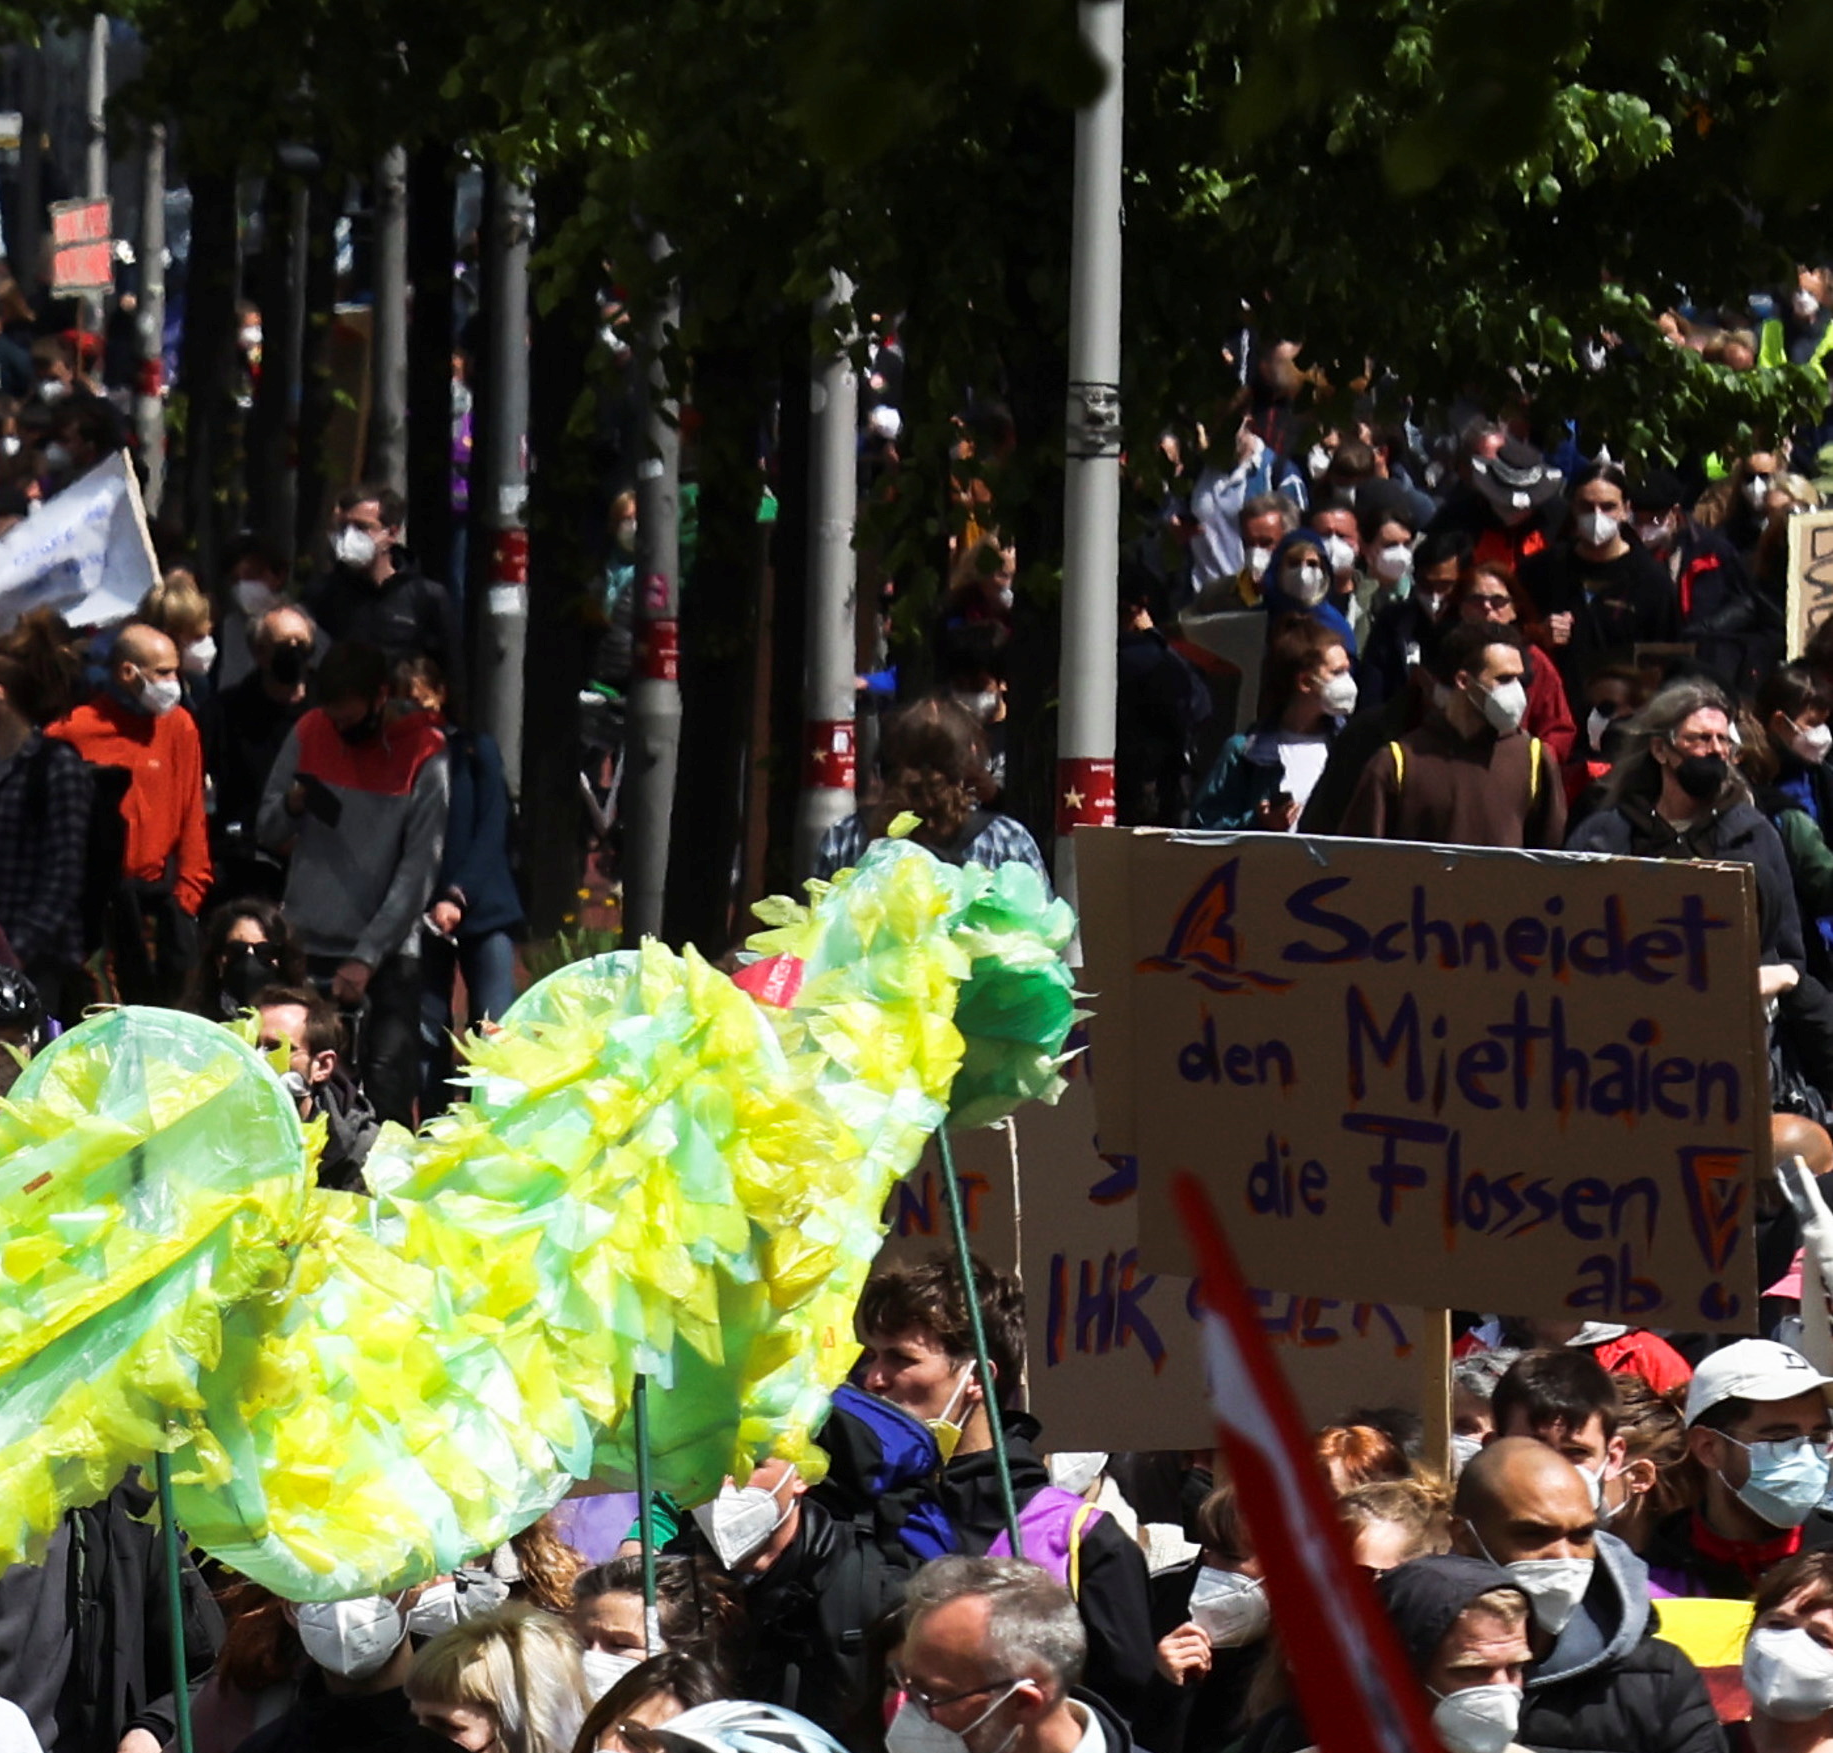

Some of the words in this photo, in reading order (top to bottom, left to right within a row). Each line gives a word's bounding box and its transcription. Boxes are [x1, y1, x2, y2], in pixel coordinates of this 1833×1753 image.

[1282, 875, 1727, 992] Schneidet
[1179, 1015, 1294, 1092] den
[1345, 984, 1742, 1123] Miethaien
[1247, 1131, 1330, 1218] die
[1342, 1112, 1660, 1246] Flossen
